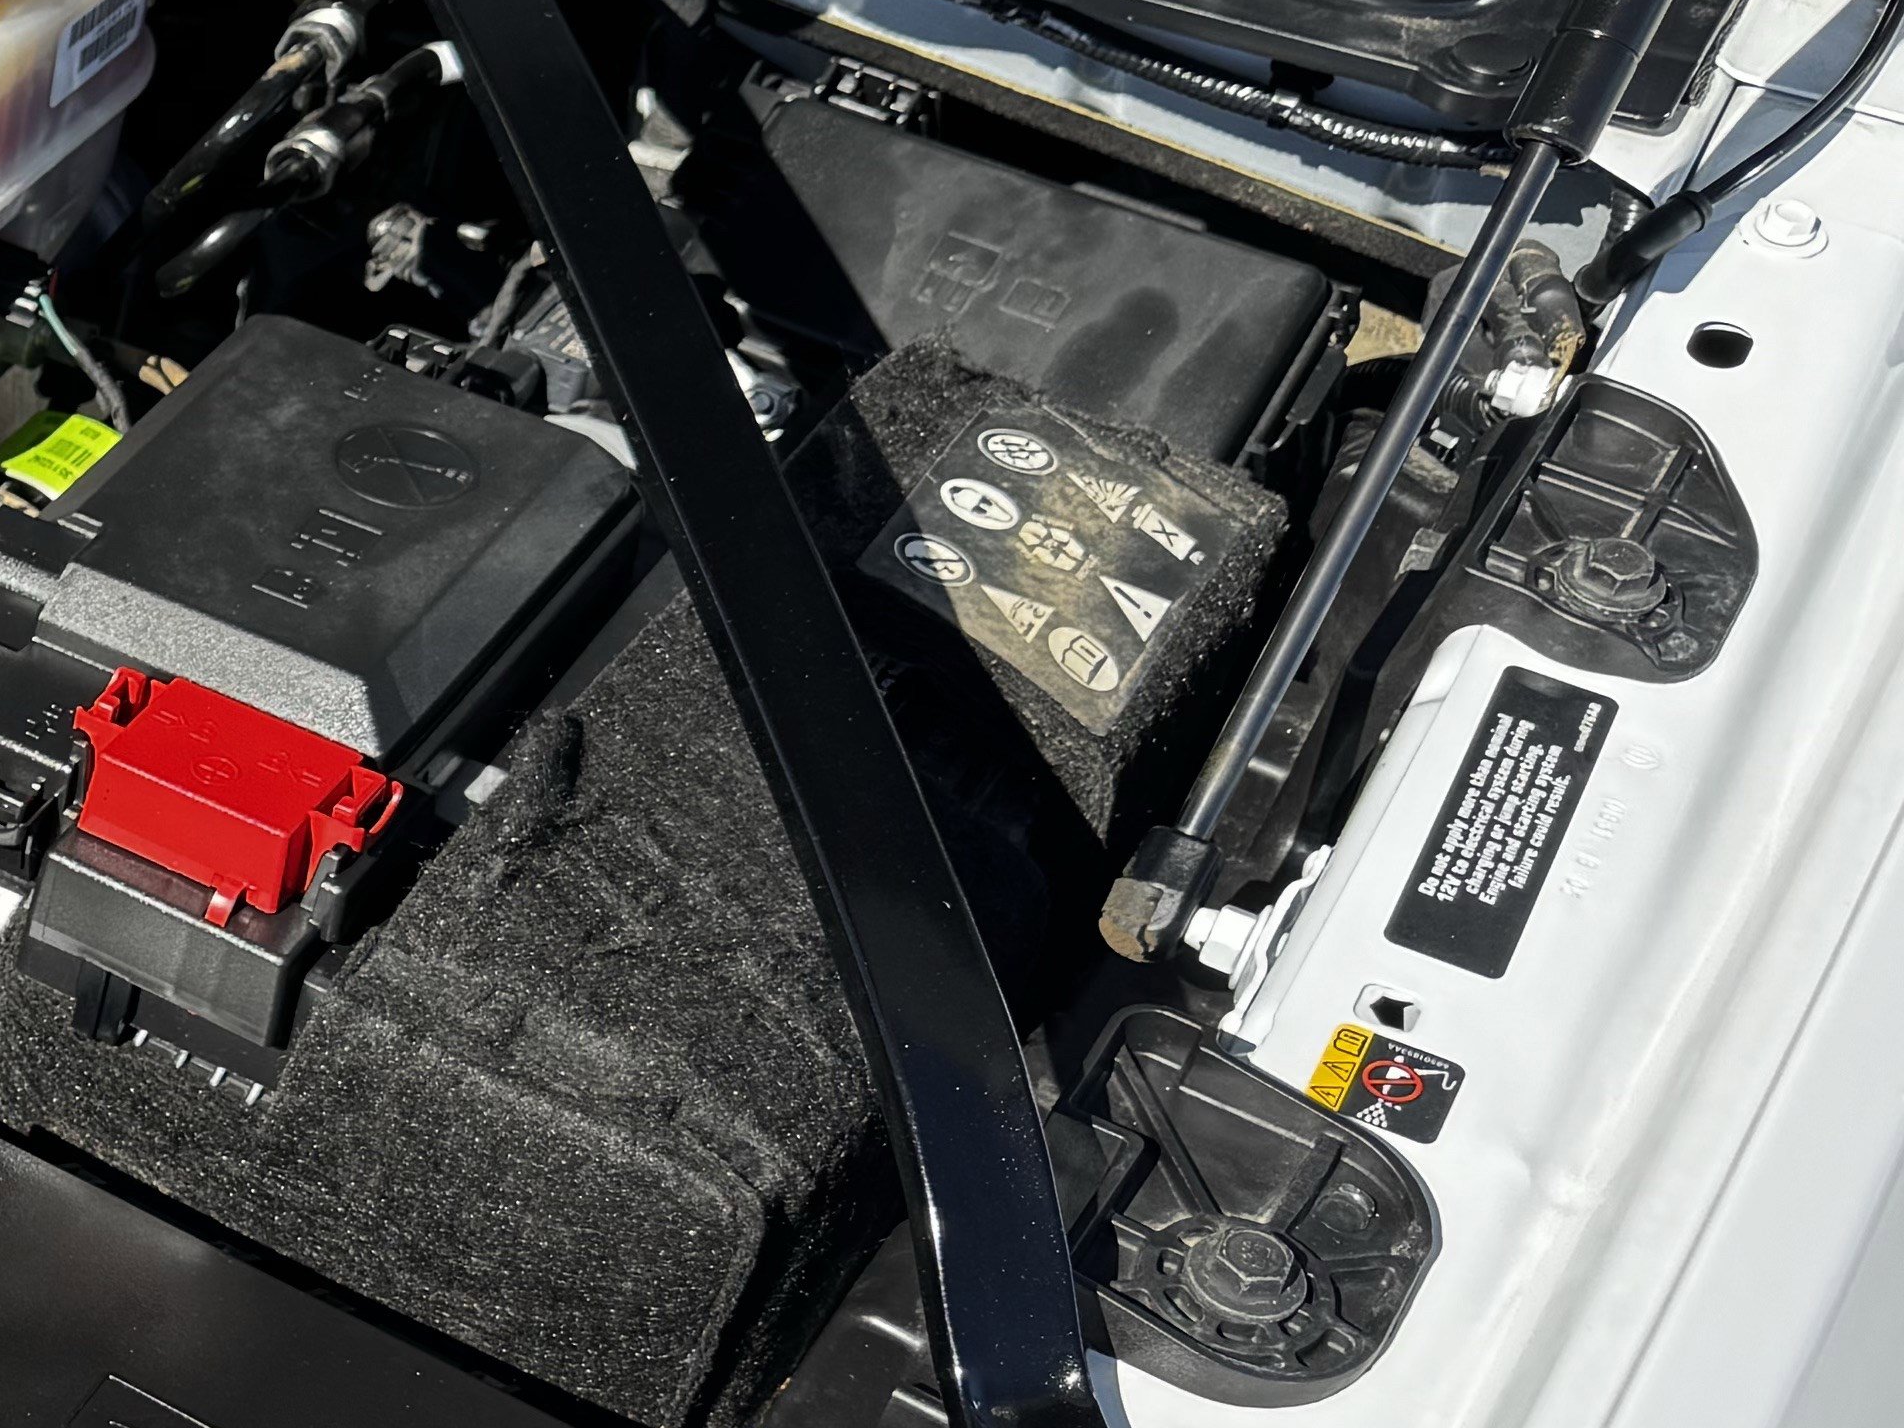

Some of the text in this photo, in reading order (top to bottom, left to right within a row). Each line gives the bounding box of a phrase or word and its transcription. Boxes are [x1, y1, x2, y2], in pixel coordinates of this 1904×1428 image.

[1418, 881, 1439, 898] Do
[1431, 852, 1451, 877] not
[1441, 818, 1469, 853] apply
[1456, 786, 1481, 819] more
[1469, 758, 1494, 788] than
[1436, 718, 1536, 902] 12V to electrical system during
[1464, 743, 1545, 895] charging or jump starting.
[1478, 743, 1565, 906] Engine and starting system
[1508, 774, 1573, 890] failure could result.
